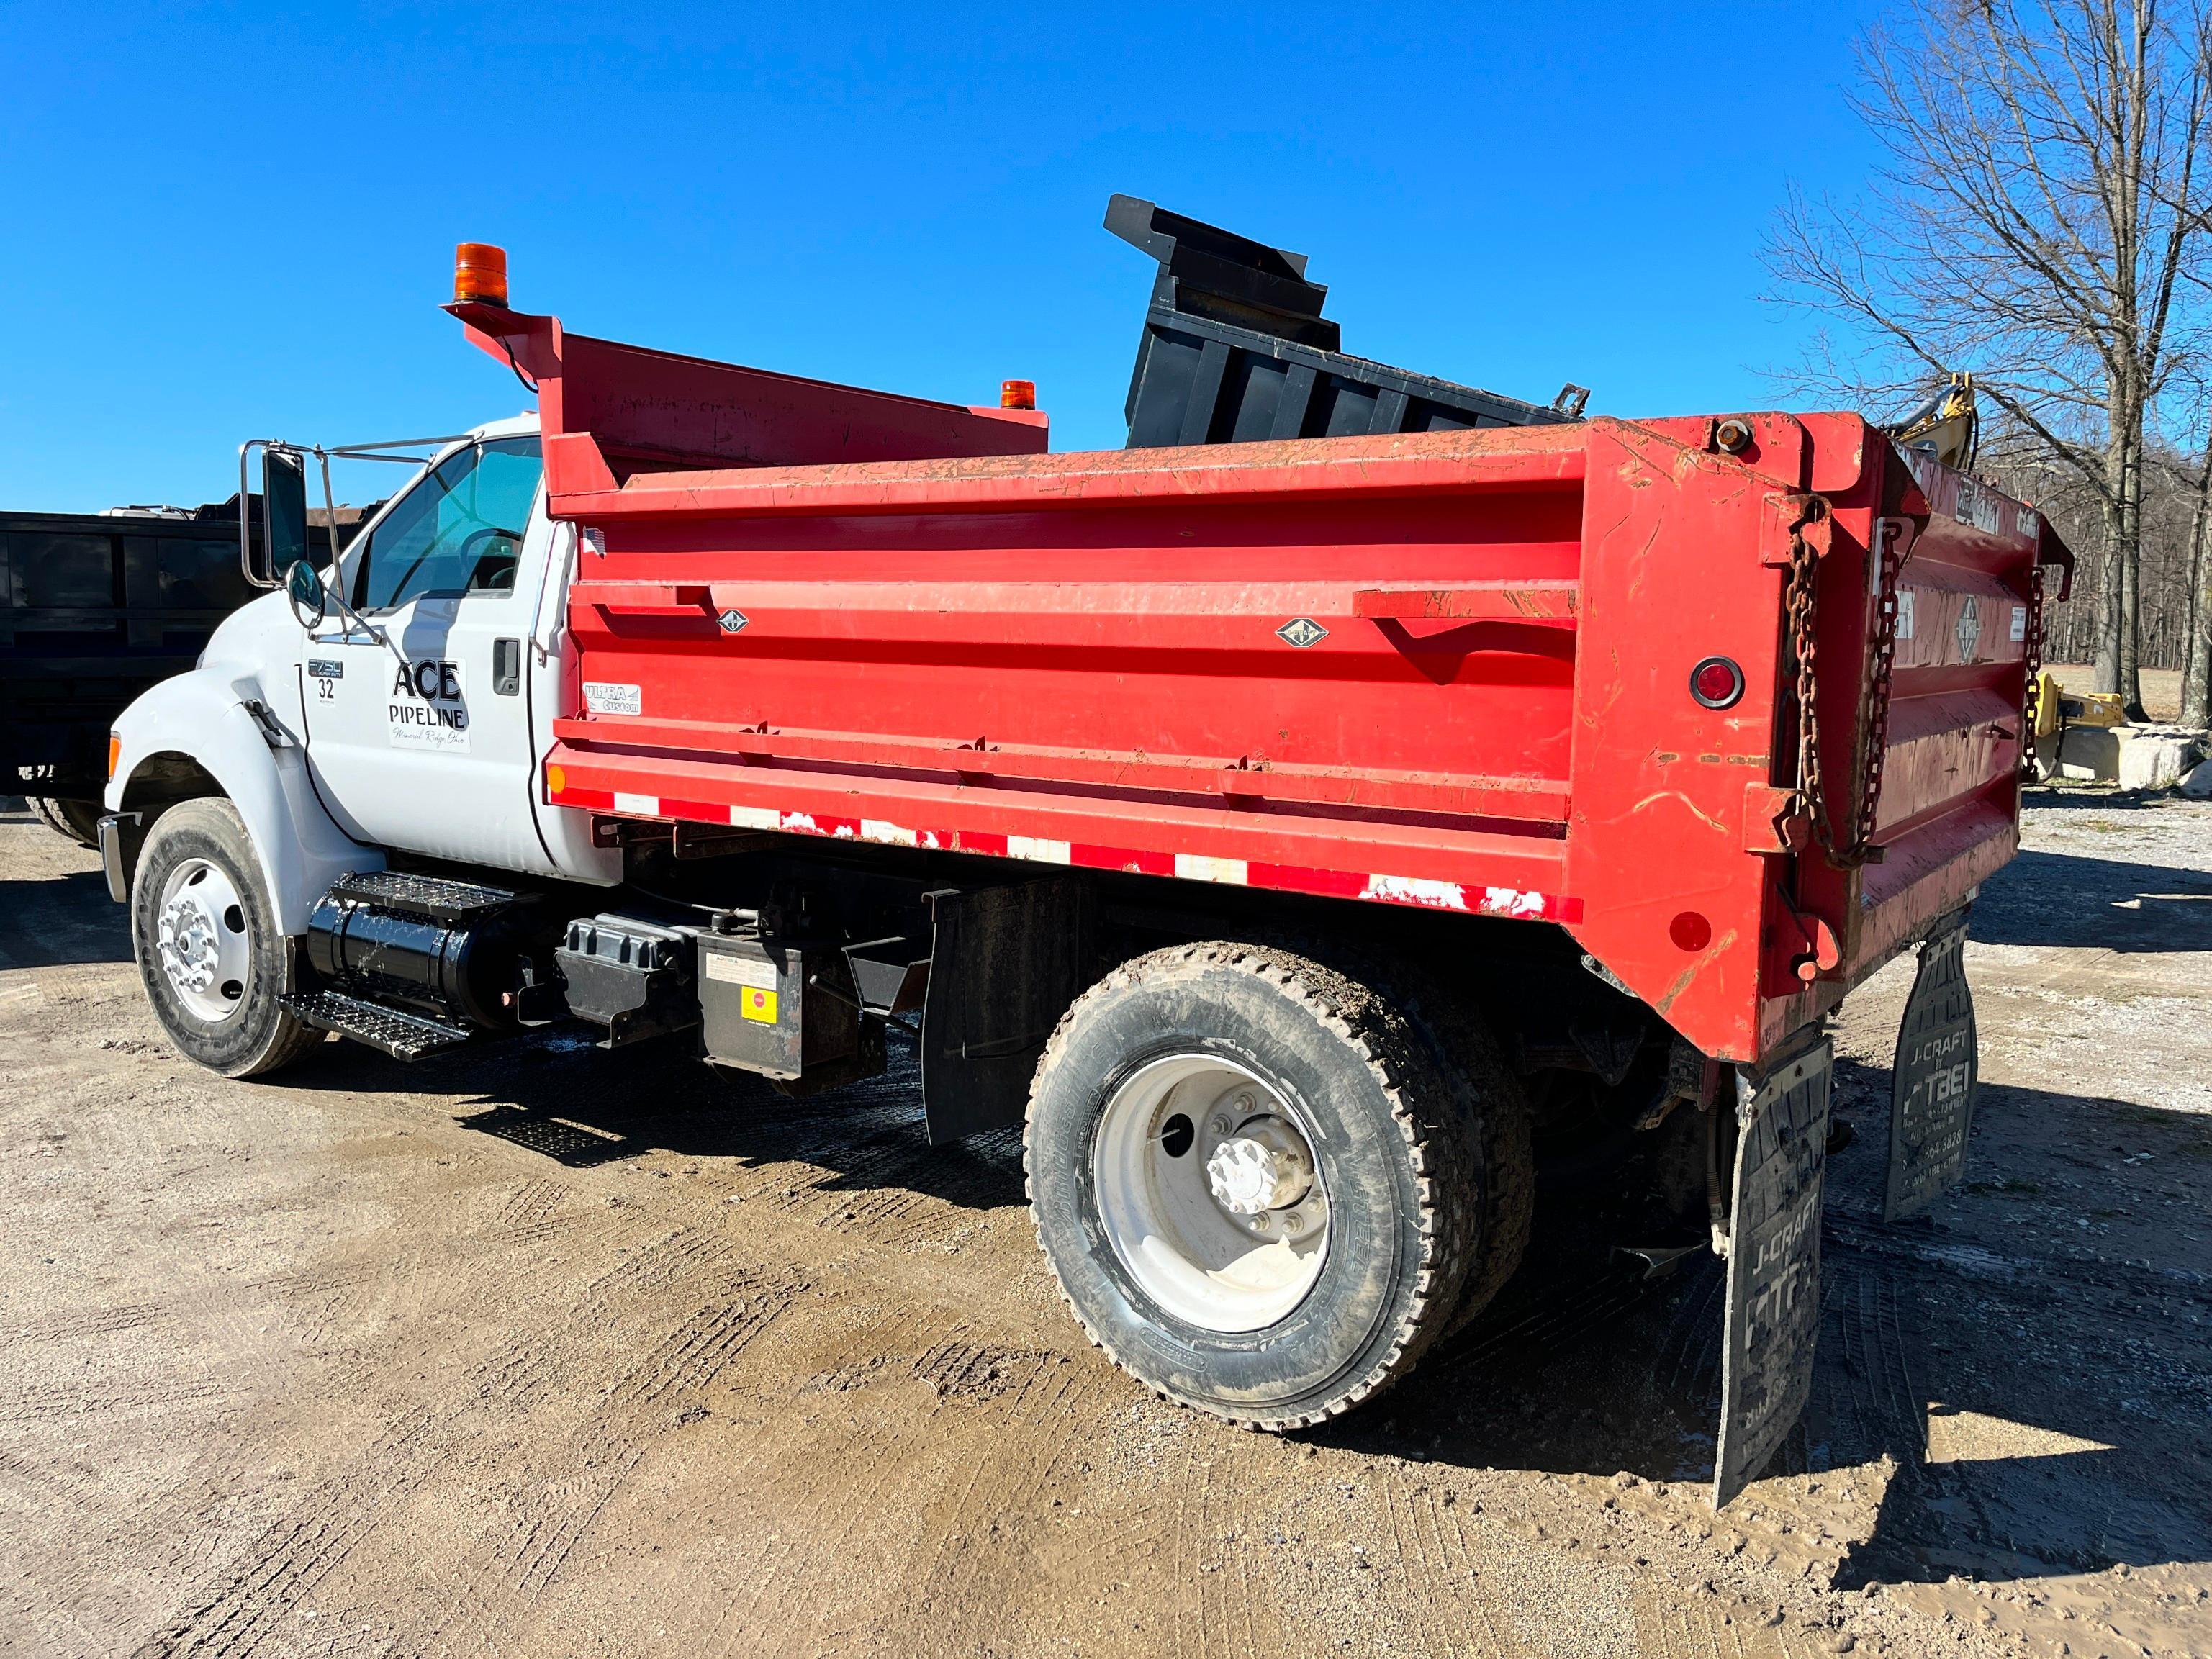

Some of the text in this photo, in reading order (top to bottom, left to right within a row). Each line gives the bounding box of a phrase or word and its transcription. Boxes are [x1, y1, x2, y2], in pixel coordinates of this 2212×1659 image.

[318, 678, 334, 699] 32
[392, 659, 461, 702] ACE
[585, 684, 627, 700] ULTRA
[603, 700, 639, 713] Custom
[389, 705, 465, 729] PIPELINE
[392, 726, 425, 740] Mineral
[446, 730, 465, 744] Ohio
